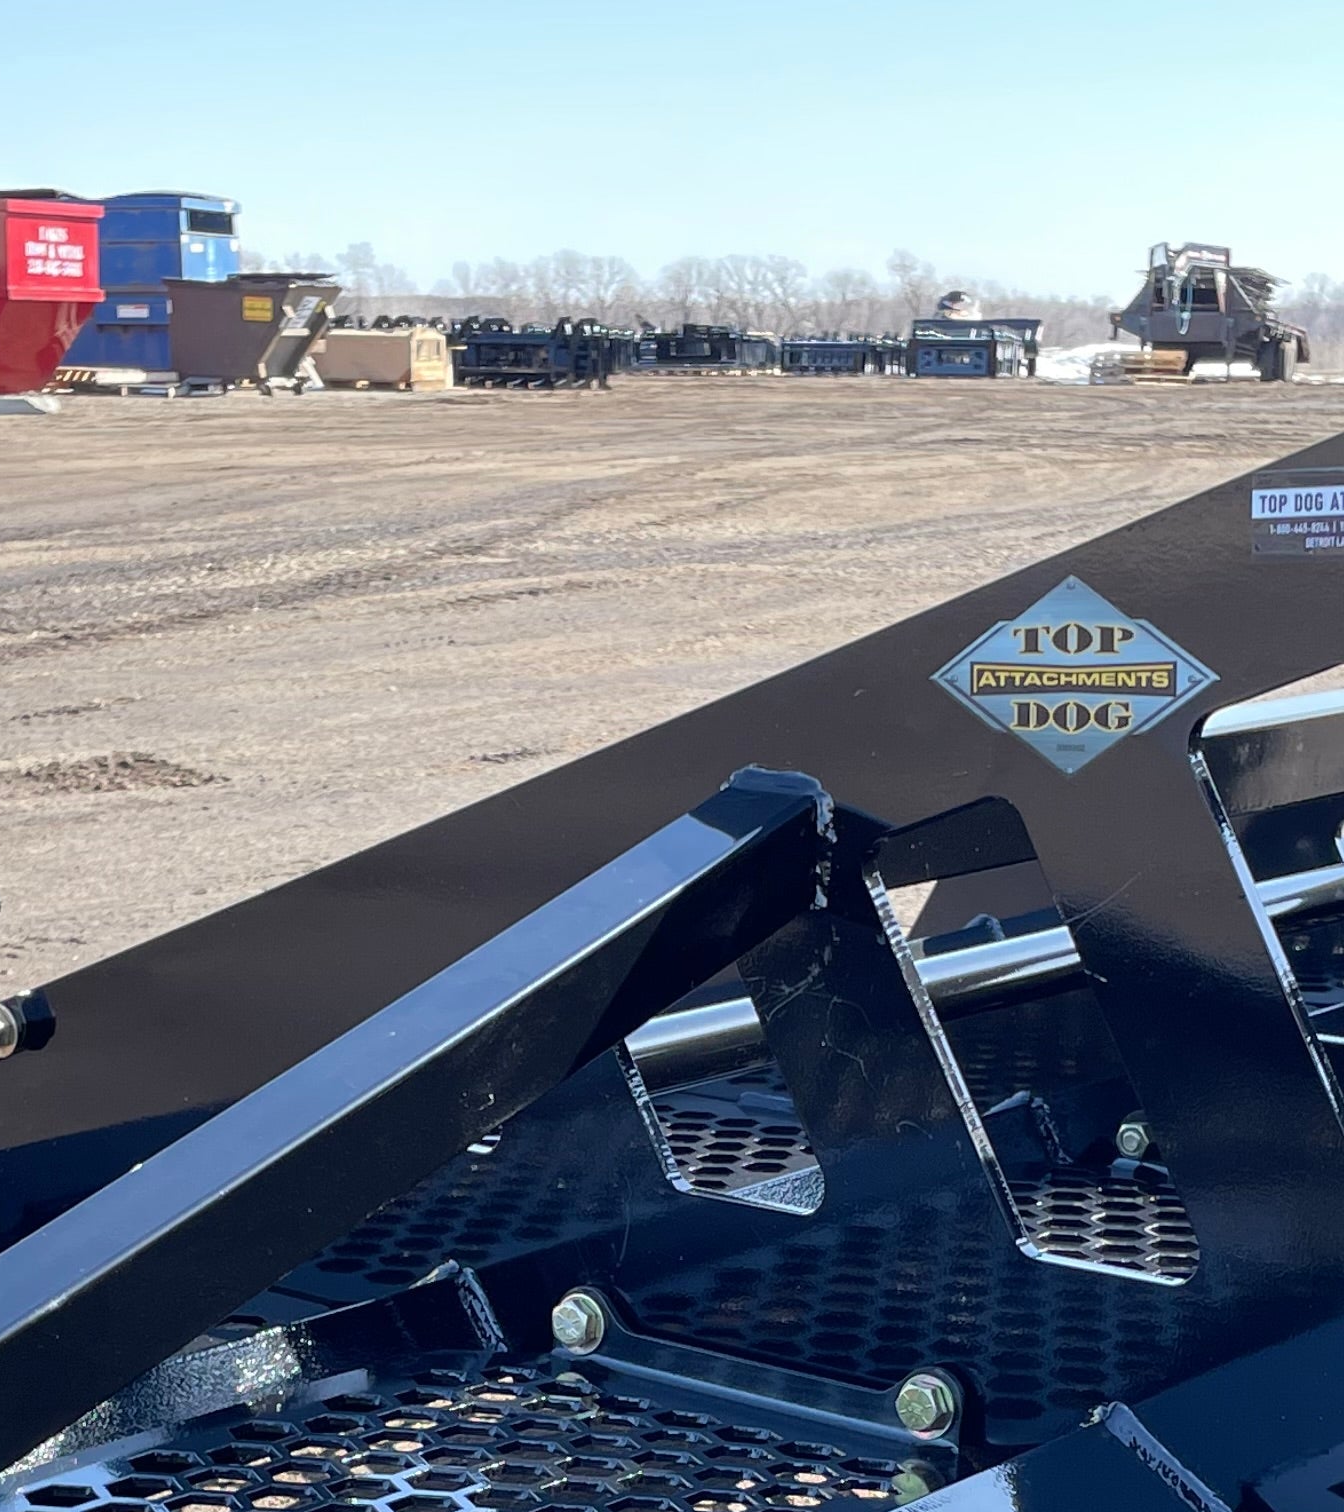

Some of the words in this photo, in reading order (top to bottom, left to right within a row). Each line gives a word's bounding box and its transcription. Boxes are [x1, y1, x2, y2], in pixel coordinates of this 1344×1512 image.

[1259, 493, 1288, 514] TOP
[1294, 491, 1324, 513] DOG
[1013, 623, 1135, 654] TOP
[978, 671, 1169, 688] ATTACHMENTS
[1011, 700, 1133, 733] DOG
